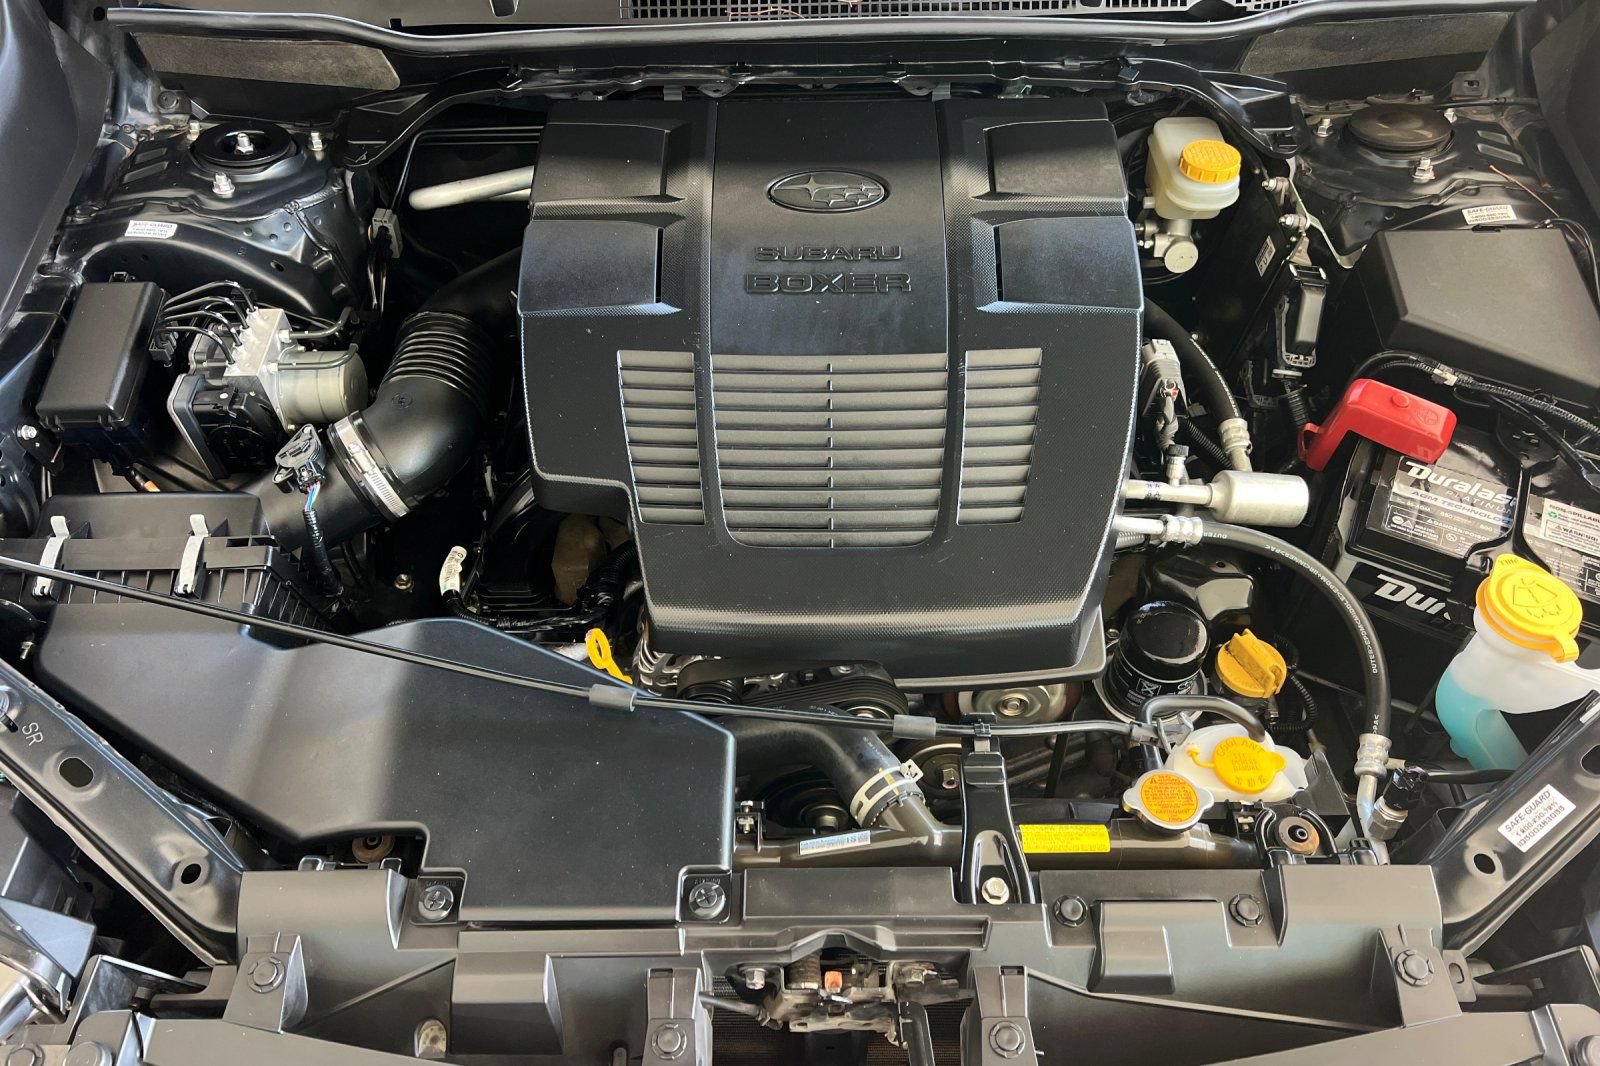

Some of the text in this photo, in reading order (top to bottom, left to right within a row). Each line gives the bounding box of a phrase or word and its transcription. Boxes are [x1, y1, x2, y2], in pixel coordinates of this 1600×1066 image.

[755, 246, 902, 260] SUBARU
[746, 273, 912, 293] BOXER
[1406, 461, 1515, 506] Duralas
[22, 722, 44, 746] SR
[1505, 790, 1551, 832] SAFE-GUARD
